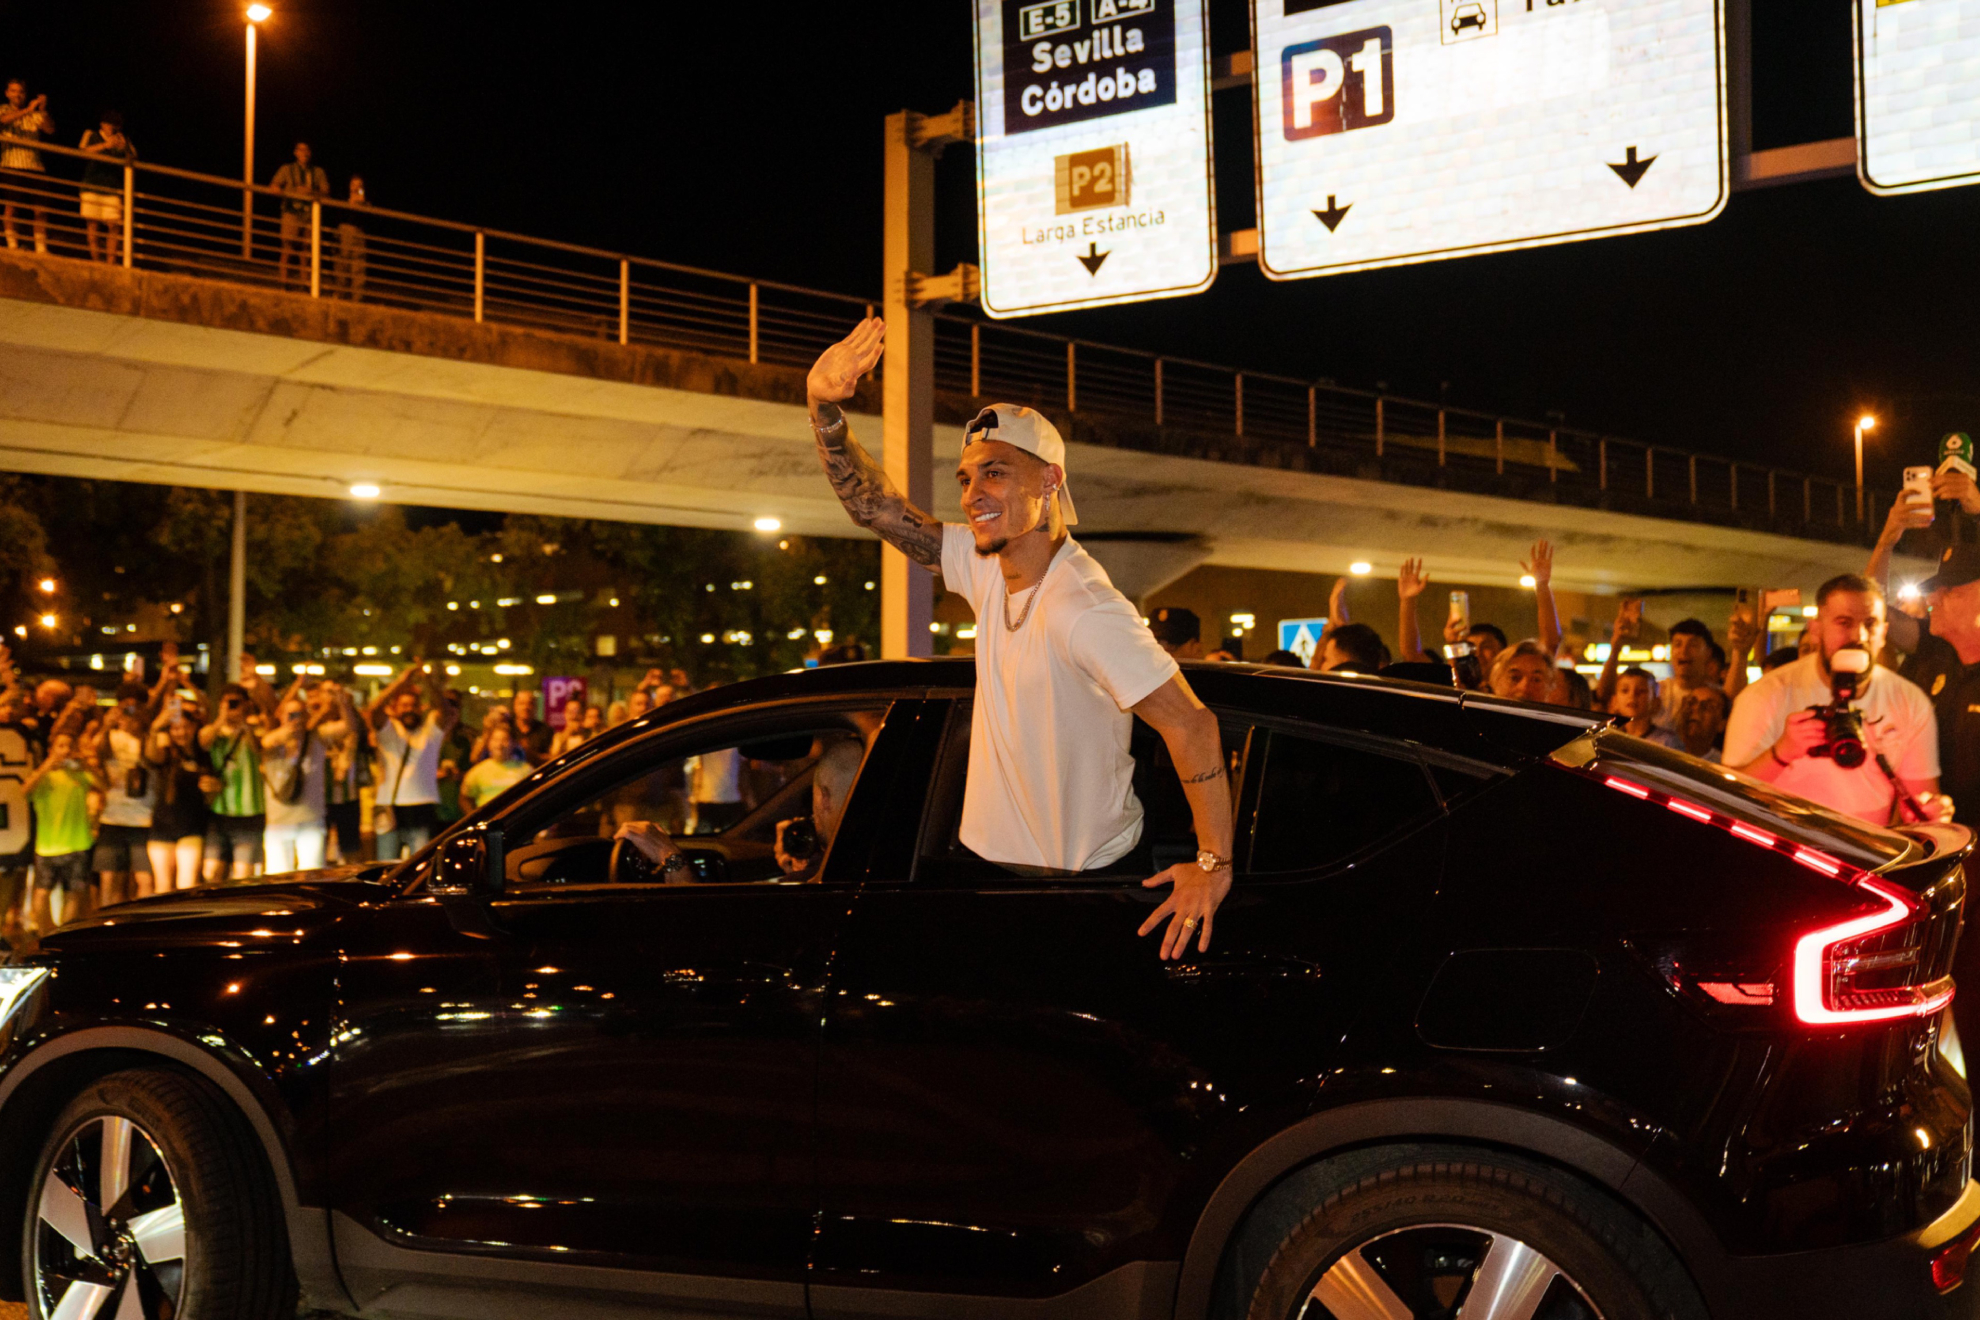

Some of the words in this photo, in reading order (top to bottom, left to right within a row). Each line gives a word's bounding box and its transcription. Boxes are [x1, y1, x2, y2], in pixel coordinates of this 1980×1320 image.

[1029, 3, 1071, 34] E-5
[1031, 25, 1145, 73] Sevilla
[1021, 67, 1157, 116] Córdoba
[1291, 38, 1384, 129] P1
[1071, 162, 1113, 197] P2
[1022, 221, 1075, 245] Larga
[1082, 207, 1165, 235] Estancia
